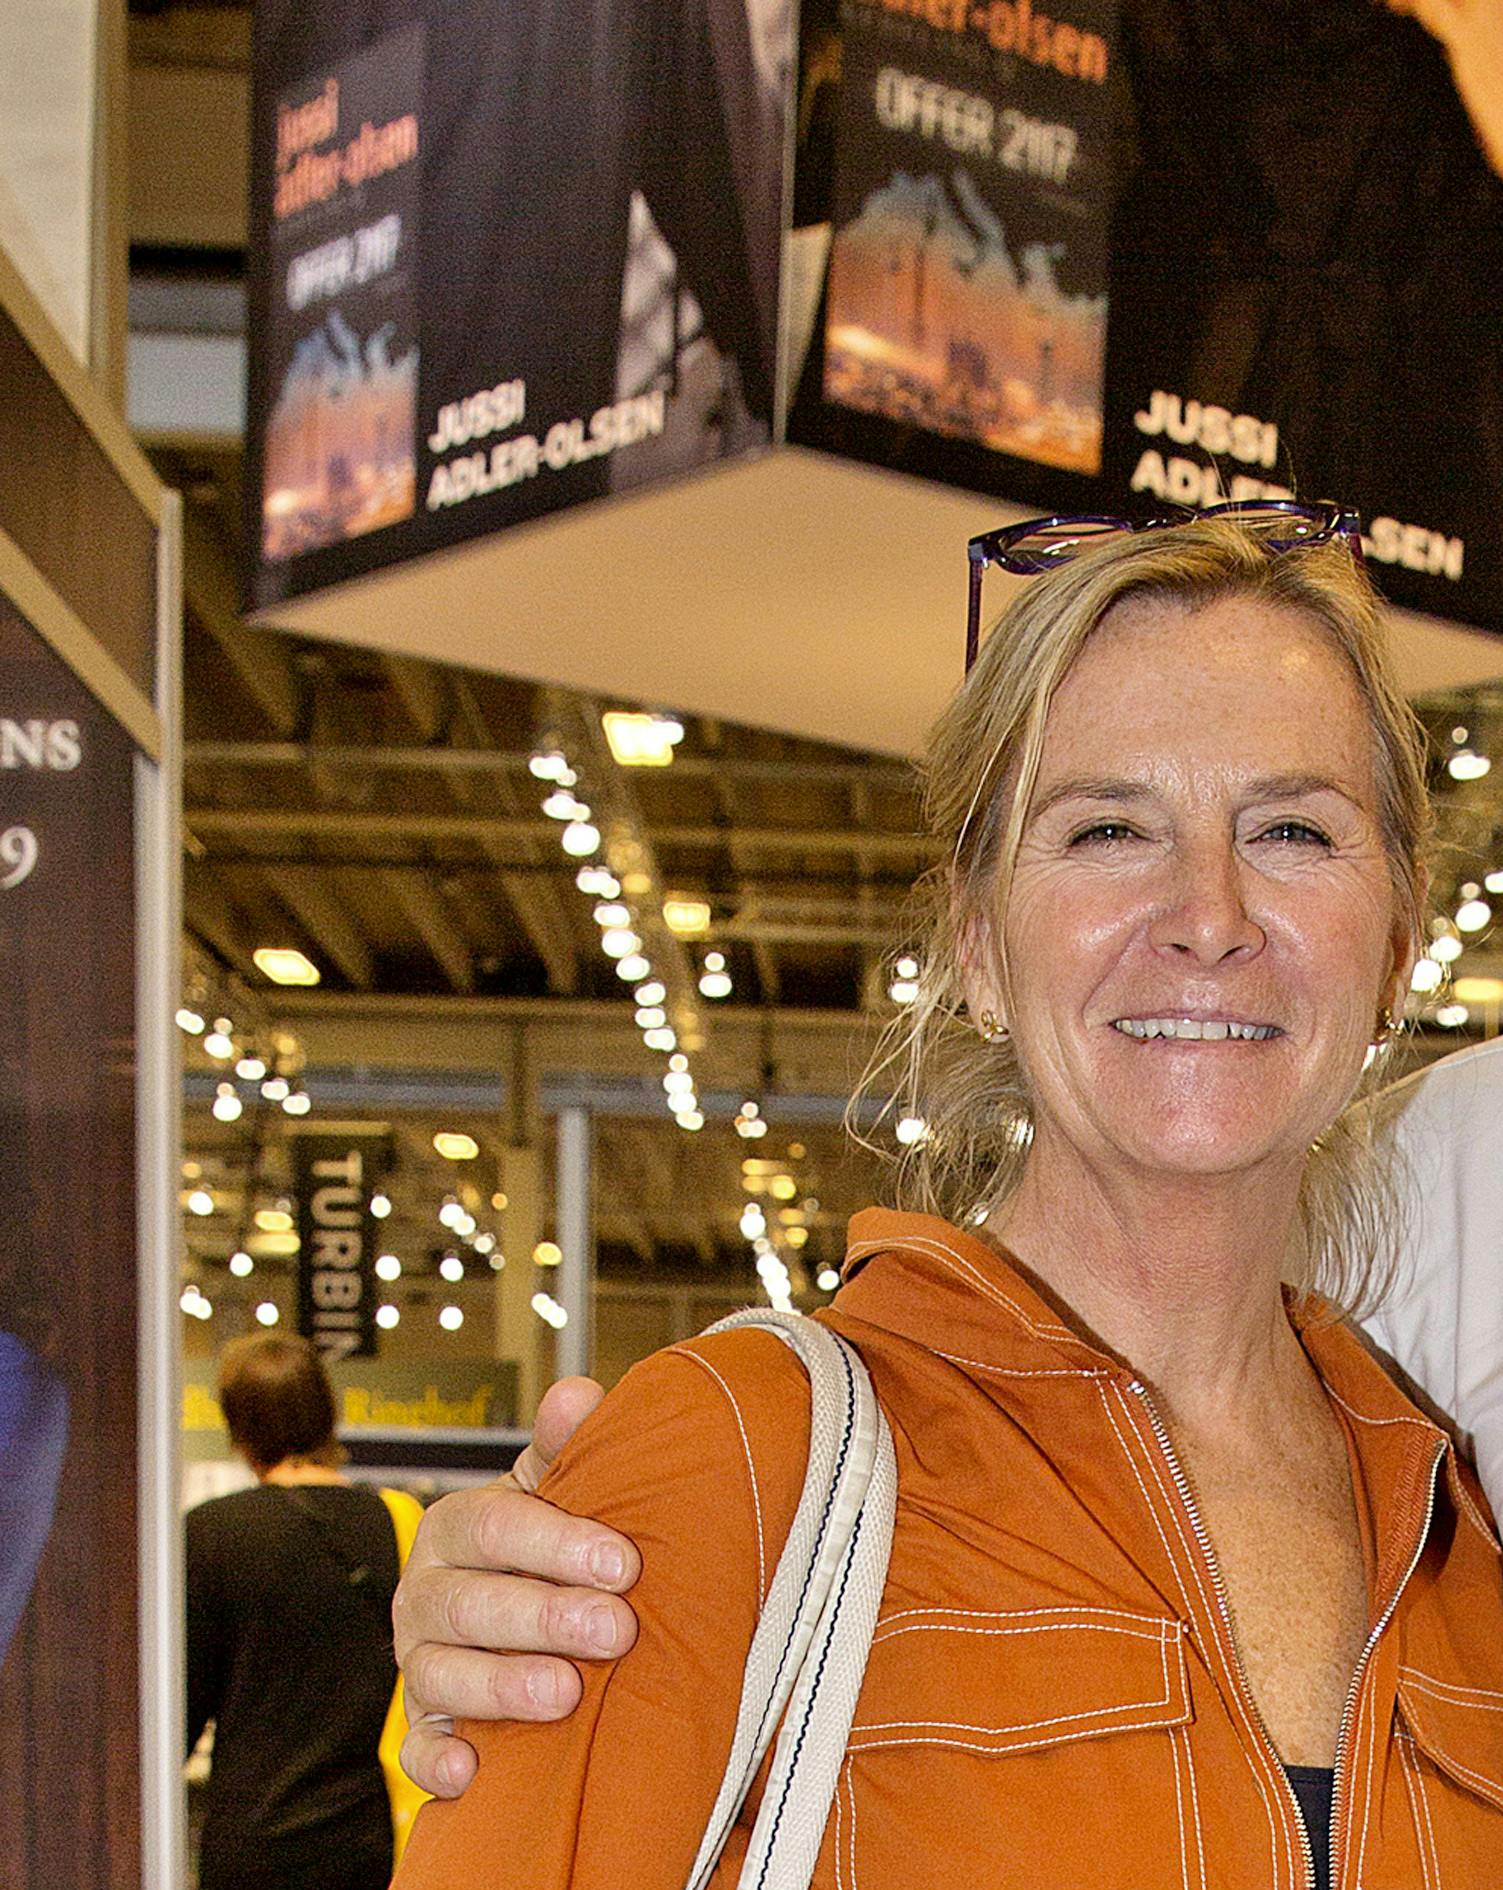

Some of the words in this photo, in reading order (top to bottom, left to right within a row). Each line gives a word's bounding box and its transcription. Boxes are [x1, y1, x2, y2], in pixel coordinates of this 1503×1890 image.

[876, 66, 994, 158] OFFER
[426, 388, 665, 512] ADLER-OLSEN
[428, 377, 526, 454] JUSSI
[1133, 388, 1279, 470] JUSSI
